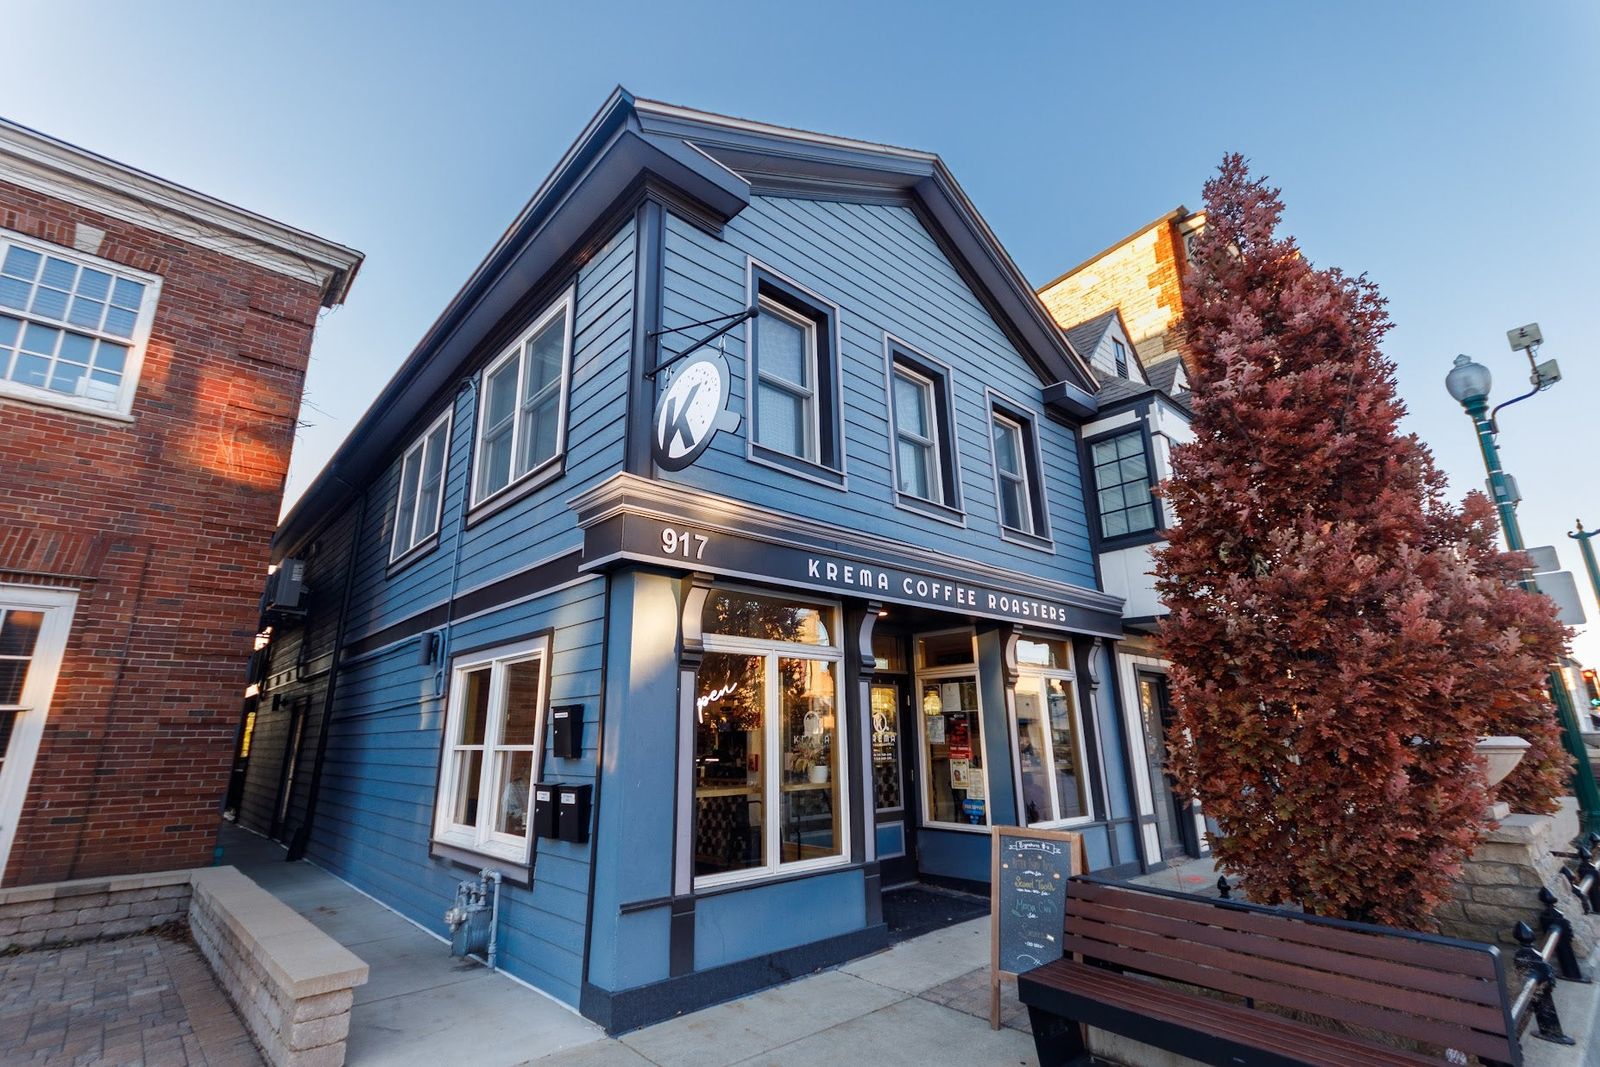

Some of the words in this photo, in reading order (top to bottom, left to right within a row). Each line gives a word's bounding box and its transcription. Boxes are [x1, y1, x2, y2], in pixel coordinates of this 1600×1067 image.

[662, 382, 702, 458] K
[661, 527, 709, 560] 917
[808, 558, 889, 590] KREMA
[902, 577, 976, 606] COFFEE
[988, 594, 1066, 622] ROASTERS
[696, 682, 738, 724] pen
[872, 734, 896, 743] REMA
